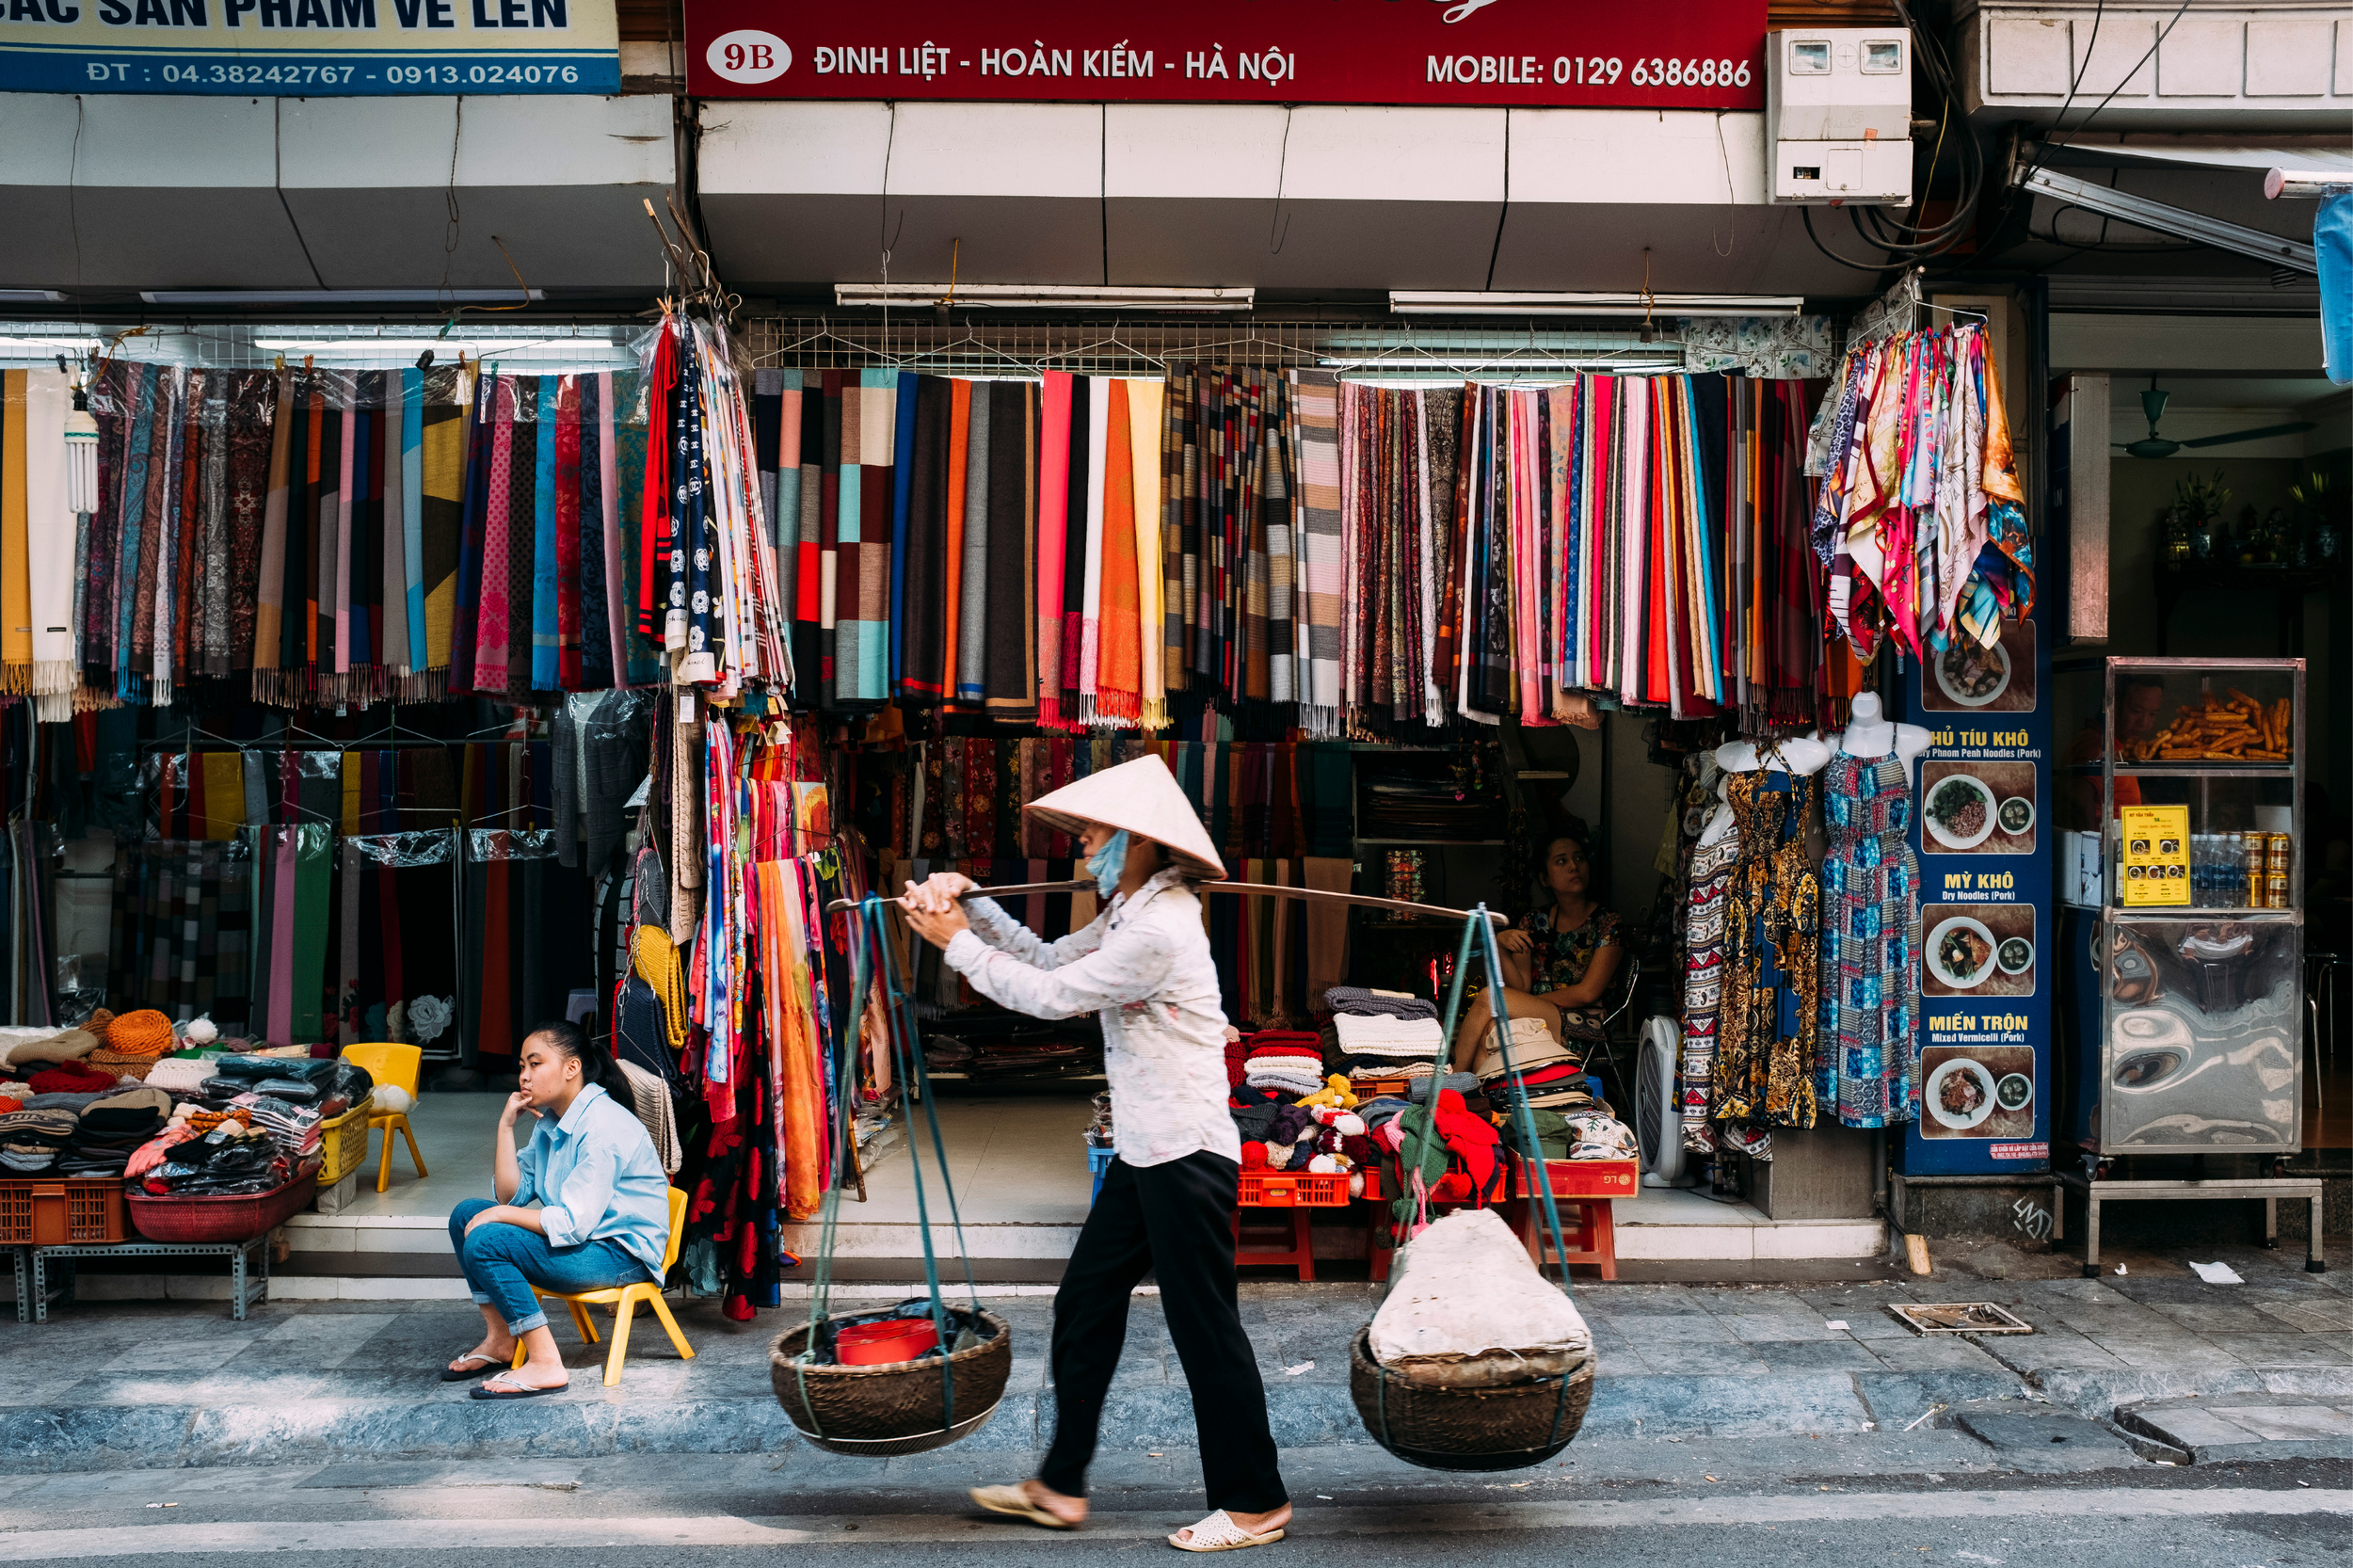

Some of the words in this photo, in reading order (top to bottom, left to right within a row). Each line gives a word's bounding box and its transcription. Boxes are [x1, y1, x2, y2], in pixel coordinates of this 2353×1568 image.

[472, 0, 567, 27] LEN
[725, 44, 774, 70] 9B
[814, 47, 888, 73] ĐINH
[900, 40, 950, 80] LIỆT
[982, 40, 1071, 75] HOÀN
[1084, 40, 1153, 76] KIẾM
[1187, 42, 1228, 78] HÀ
[1240, 46, 1294, 86] NỘI
[87, 63, 130, 81] ĐT
[163, 65, 354, 83] 04.38242767
[387, 66, 578, 83] 0913.024076
[1428, 56, 1543, 83] MOBILE:
[1554, 56, 1623, 84] 0129
[1631, 58, 1750, 87] 6386886
[1929, 726, 1953, 745] HỦ
[1960, 728, 1987, 745] TÍU
[1993, 729, 2028, 746] KHÔ
[1932, 748, 1959, 757] Phnom
[1983, 749, 2014, 758] Noodles
[2017, 749, 2041, 759] (Pork)
[1945, 872, 1972, 888] MỲ
[1978, 872, 2013, 888] KHÔ
[1943, 891, 1955, 901] Dry
[1958, 891, 1989, 900] Noodles
[1992, 891, 2015, 900] (Pork)
[1929, 1011, 1976, 1031] MIẾN
[1981, 1013, 2027, 1033] TRỘN
[1932, 1033, 1956, 1042] Mixed
[1959, 1033, 1998, 1042] Vermicelli
[2001, 1033, 2025, 1043] (Pork)
[1604, 1176, 1617, 1184] LG
